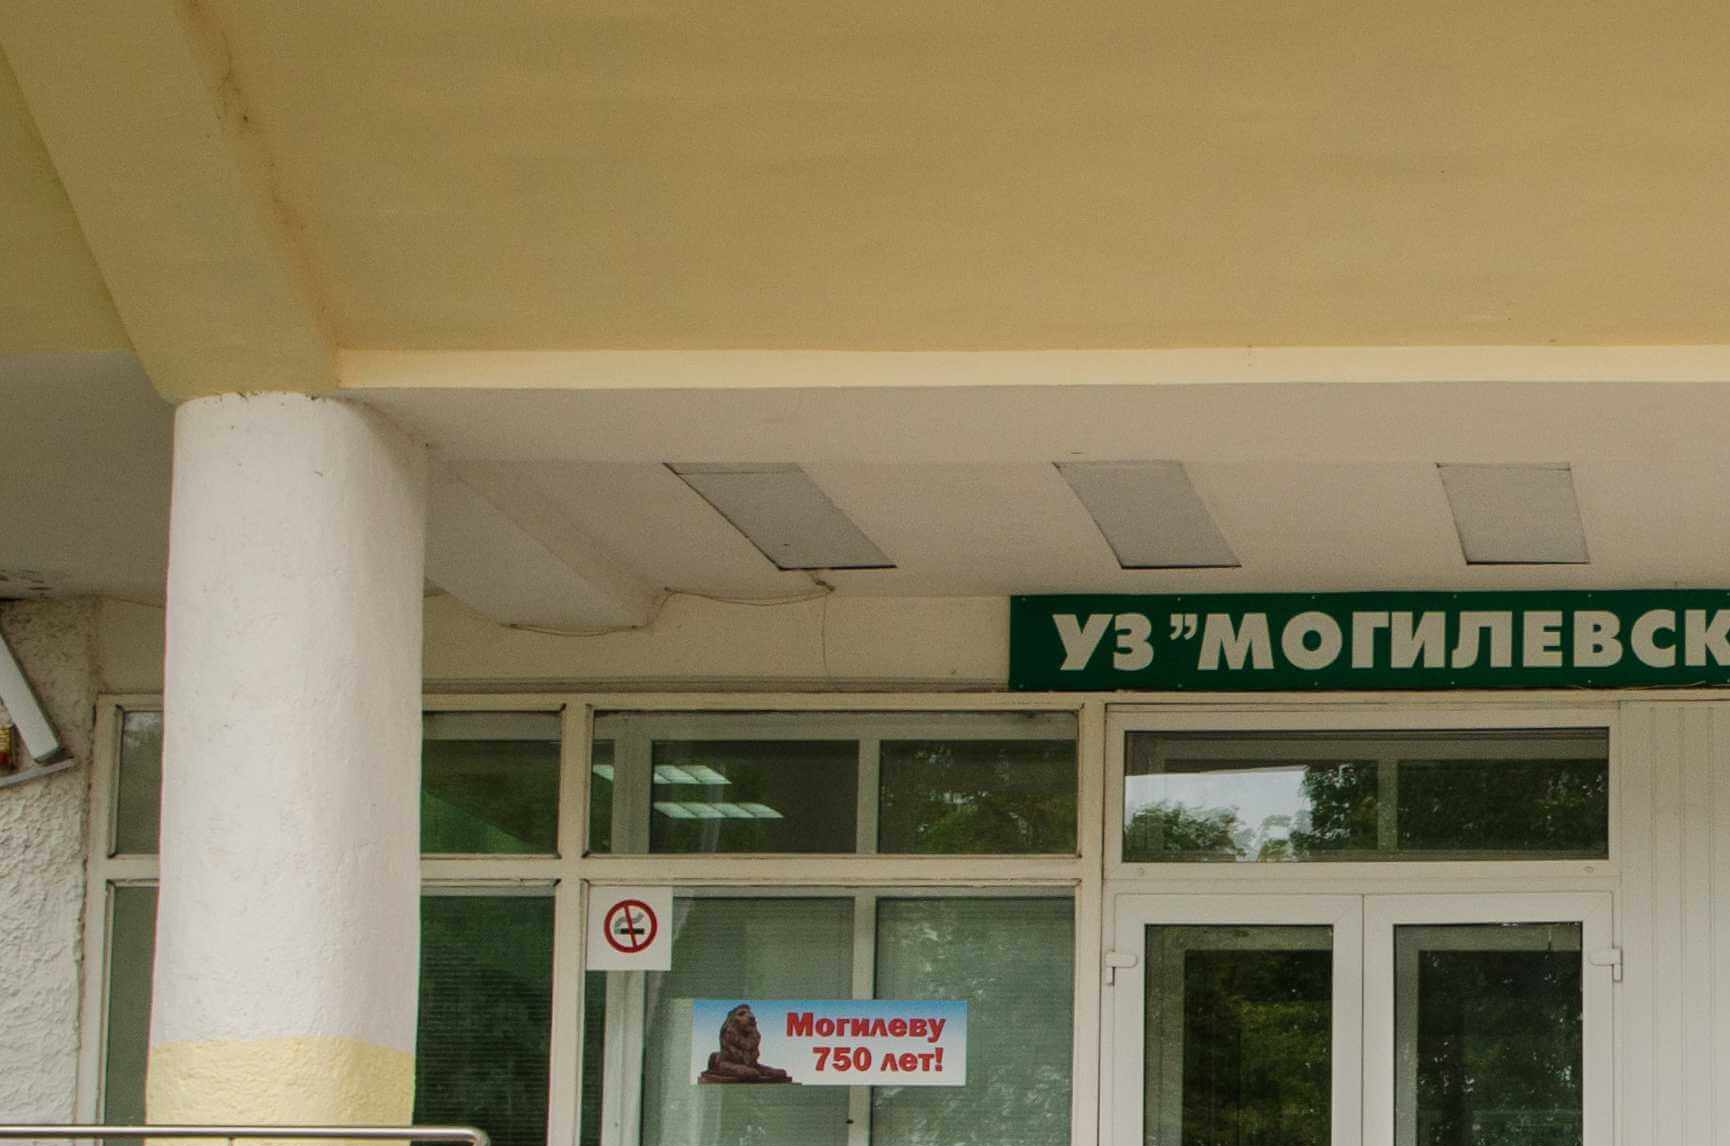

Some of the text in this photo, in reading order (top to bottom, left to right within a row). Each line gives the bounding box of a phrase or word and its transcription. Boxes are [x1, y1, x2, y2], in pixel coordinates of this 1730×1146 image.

[1053, 613, 1154, 671] УЗ
[786, 1012, 946, 1043] Могилеву
[812, 1046, 943, 1072] 750 лет!
